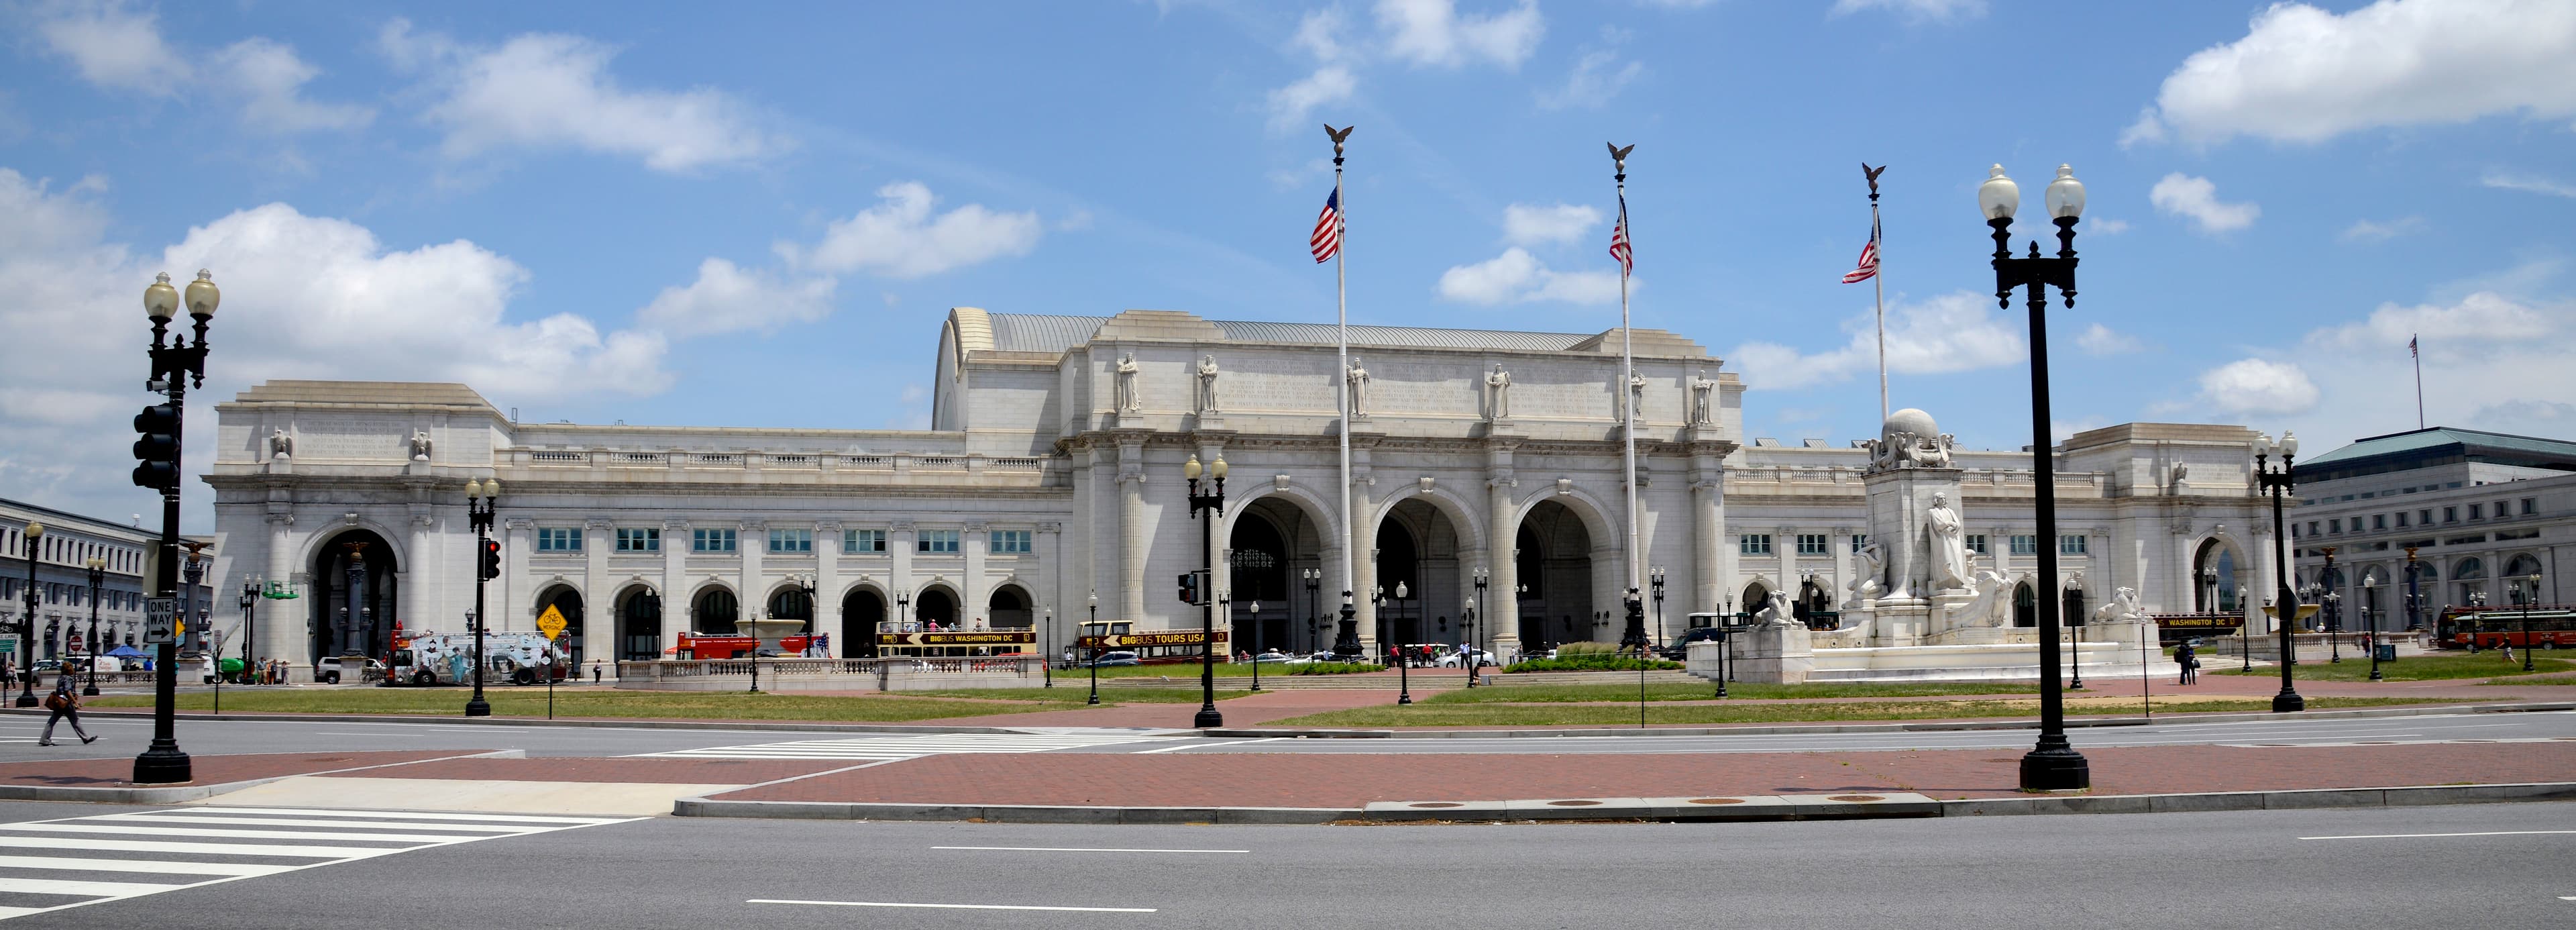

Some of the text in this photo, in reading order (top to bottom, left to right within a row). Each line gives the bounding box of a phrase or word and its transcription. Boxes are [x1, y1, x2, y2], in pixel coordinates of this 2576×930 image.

[151, 601, 171, 613] ONE
[150, 614, 171, 625] WAY
[1155, 634, 1185, 644] TOURS
[1188, 633, 1205, 642] USA
